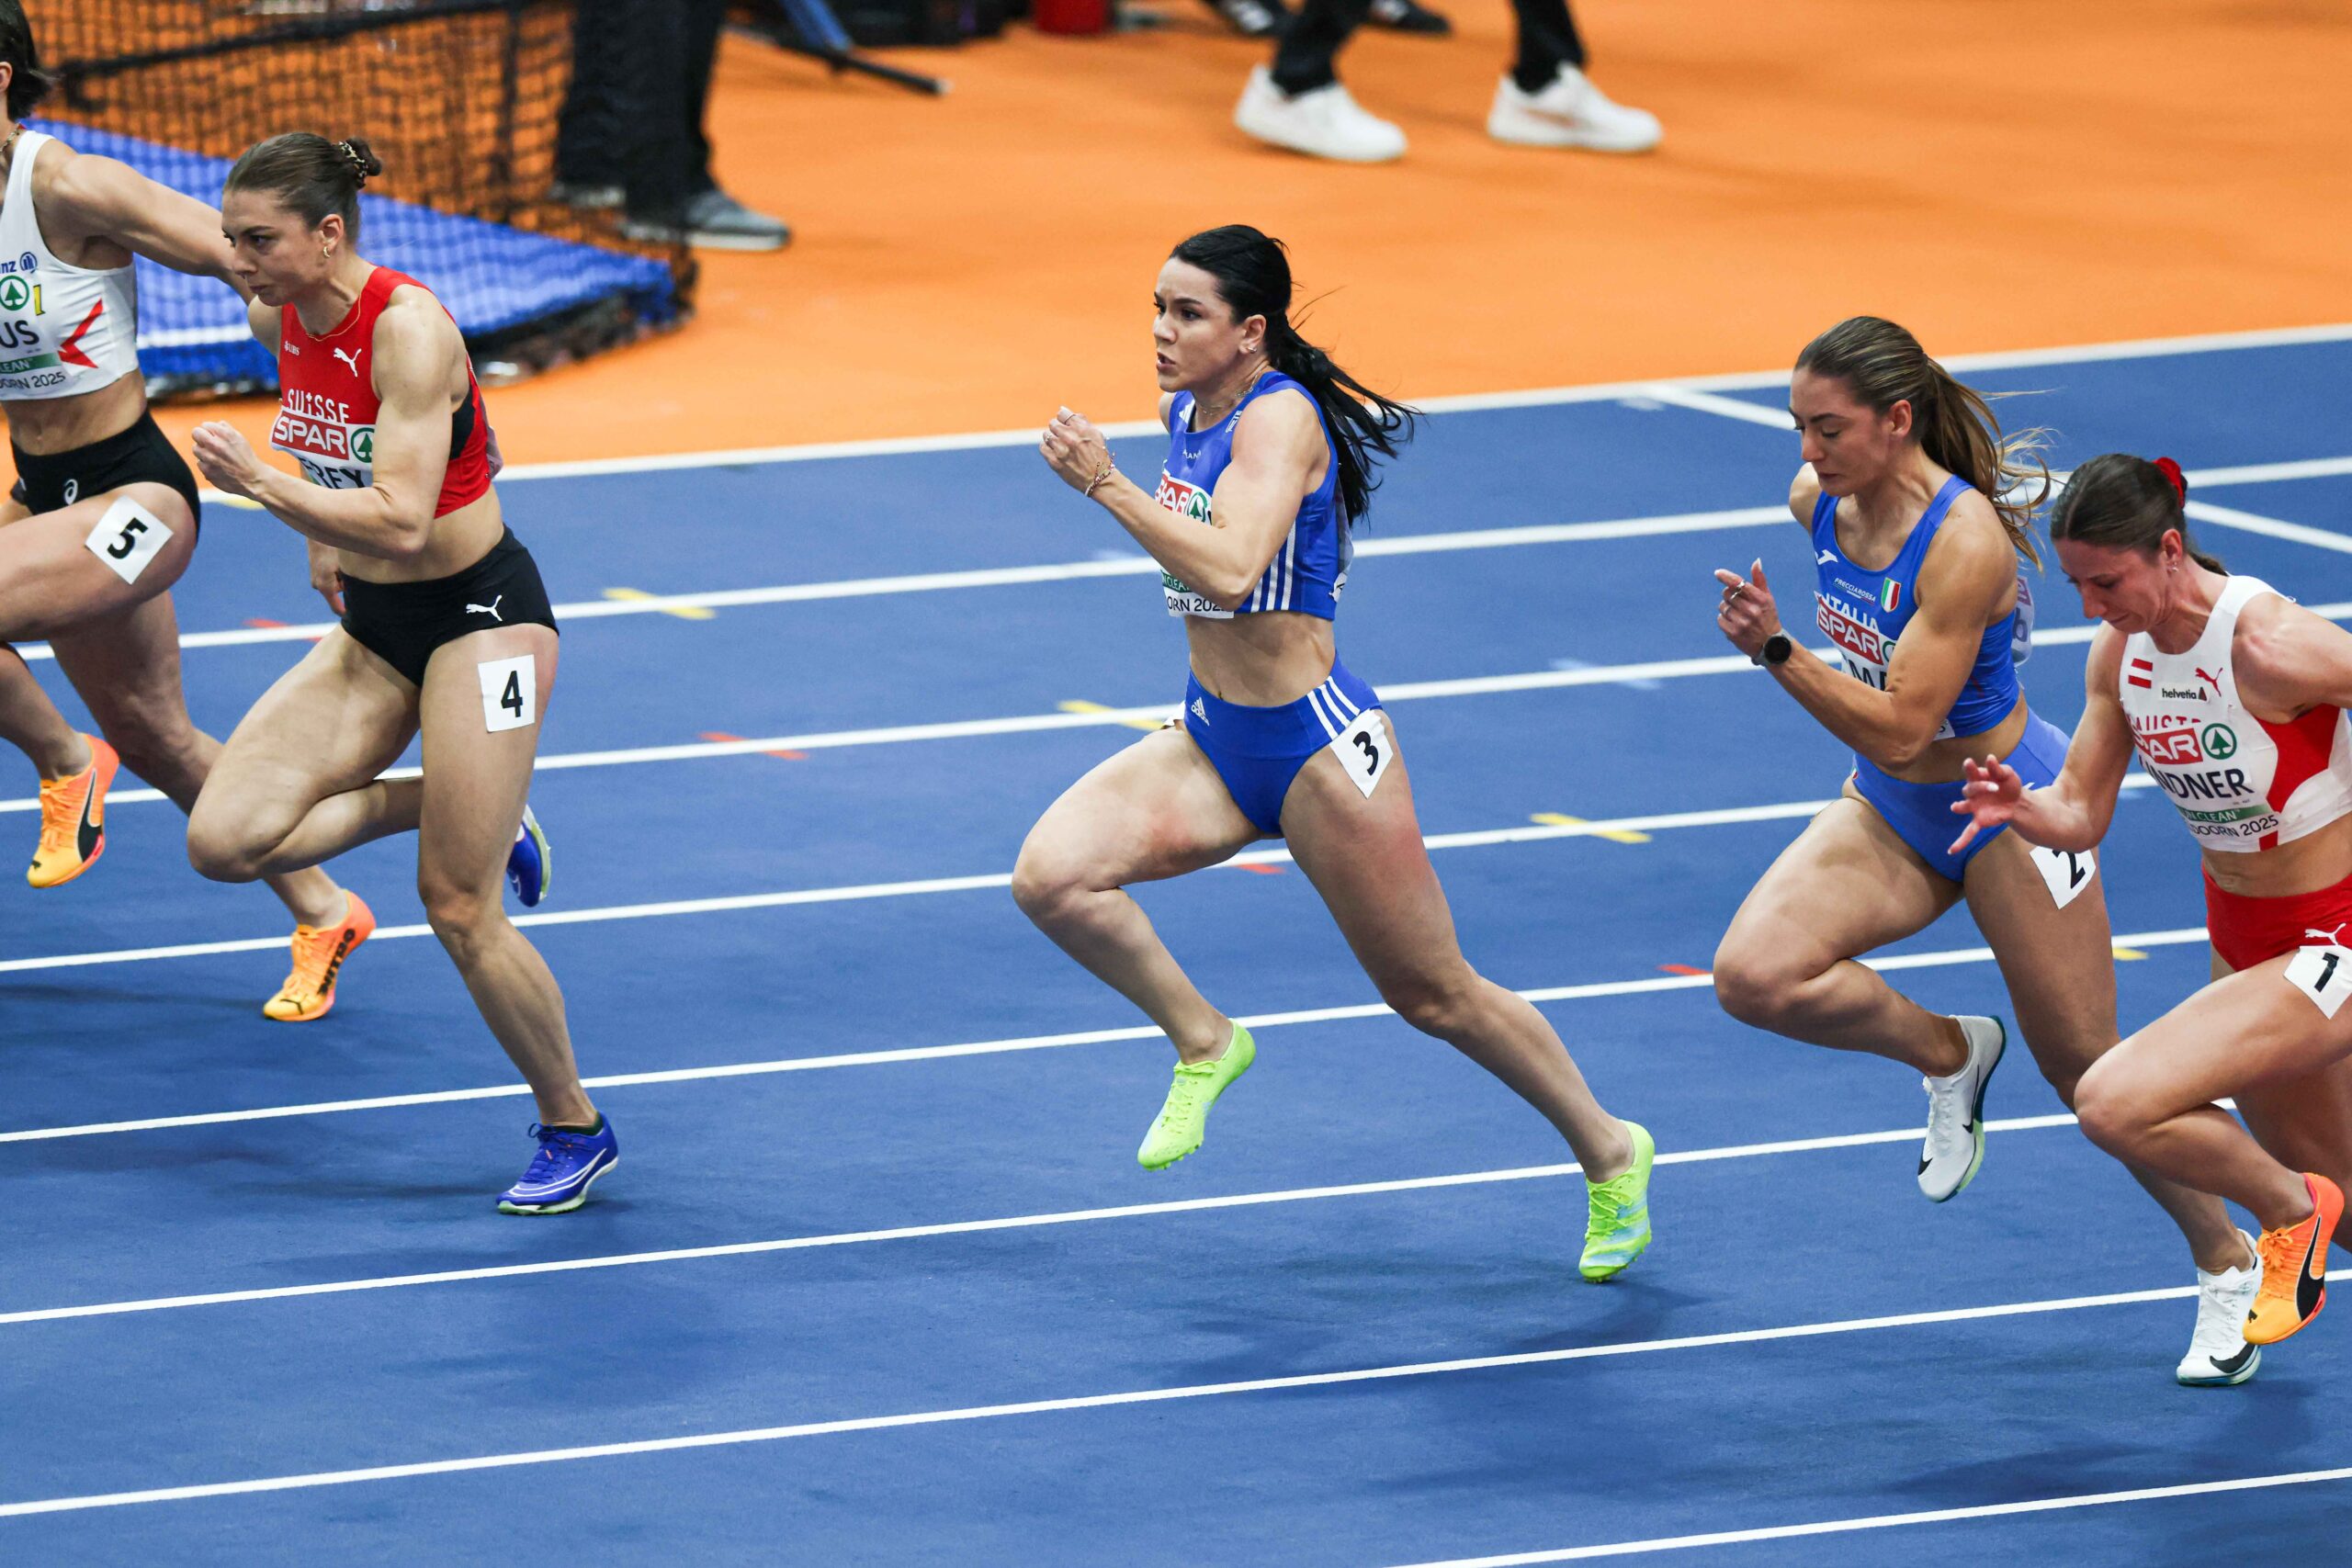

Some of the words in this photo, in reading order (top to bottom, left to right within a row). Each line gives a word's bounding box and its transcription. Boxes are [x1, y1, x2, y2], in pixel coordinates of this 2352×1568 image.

[31, 372, 66, 389] 2025
[274, 415, 346, 455] SPAR
[107, 517, 149, 560] 5
[1834, 578, 1876, 603] FRECCIAROSSA
[1819, 606, 1881, 660] SPAR
[1825, 592, 1880, 633] ITALIA
[501, 670, 524, 718] 4
[2162, 688, 2198, 700] helvetia
[1352, 730, 1379, 776] 3
[2197, 809, 2237, 823] CLEAN
[2240, 815, 2279, 837] 2025
[2052, 849, 2086, 890] 2
[2313, 952, 2340, 993] 1
